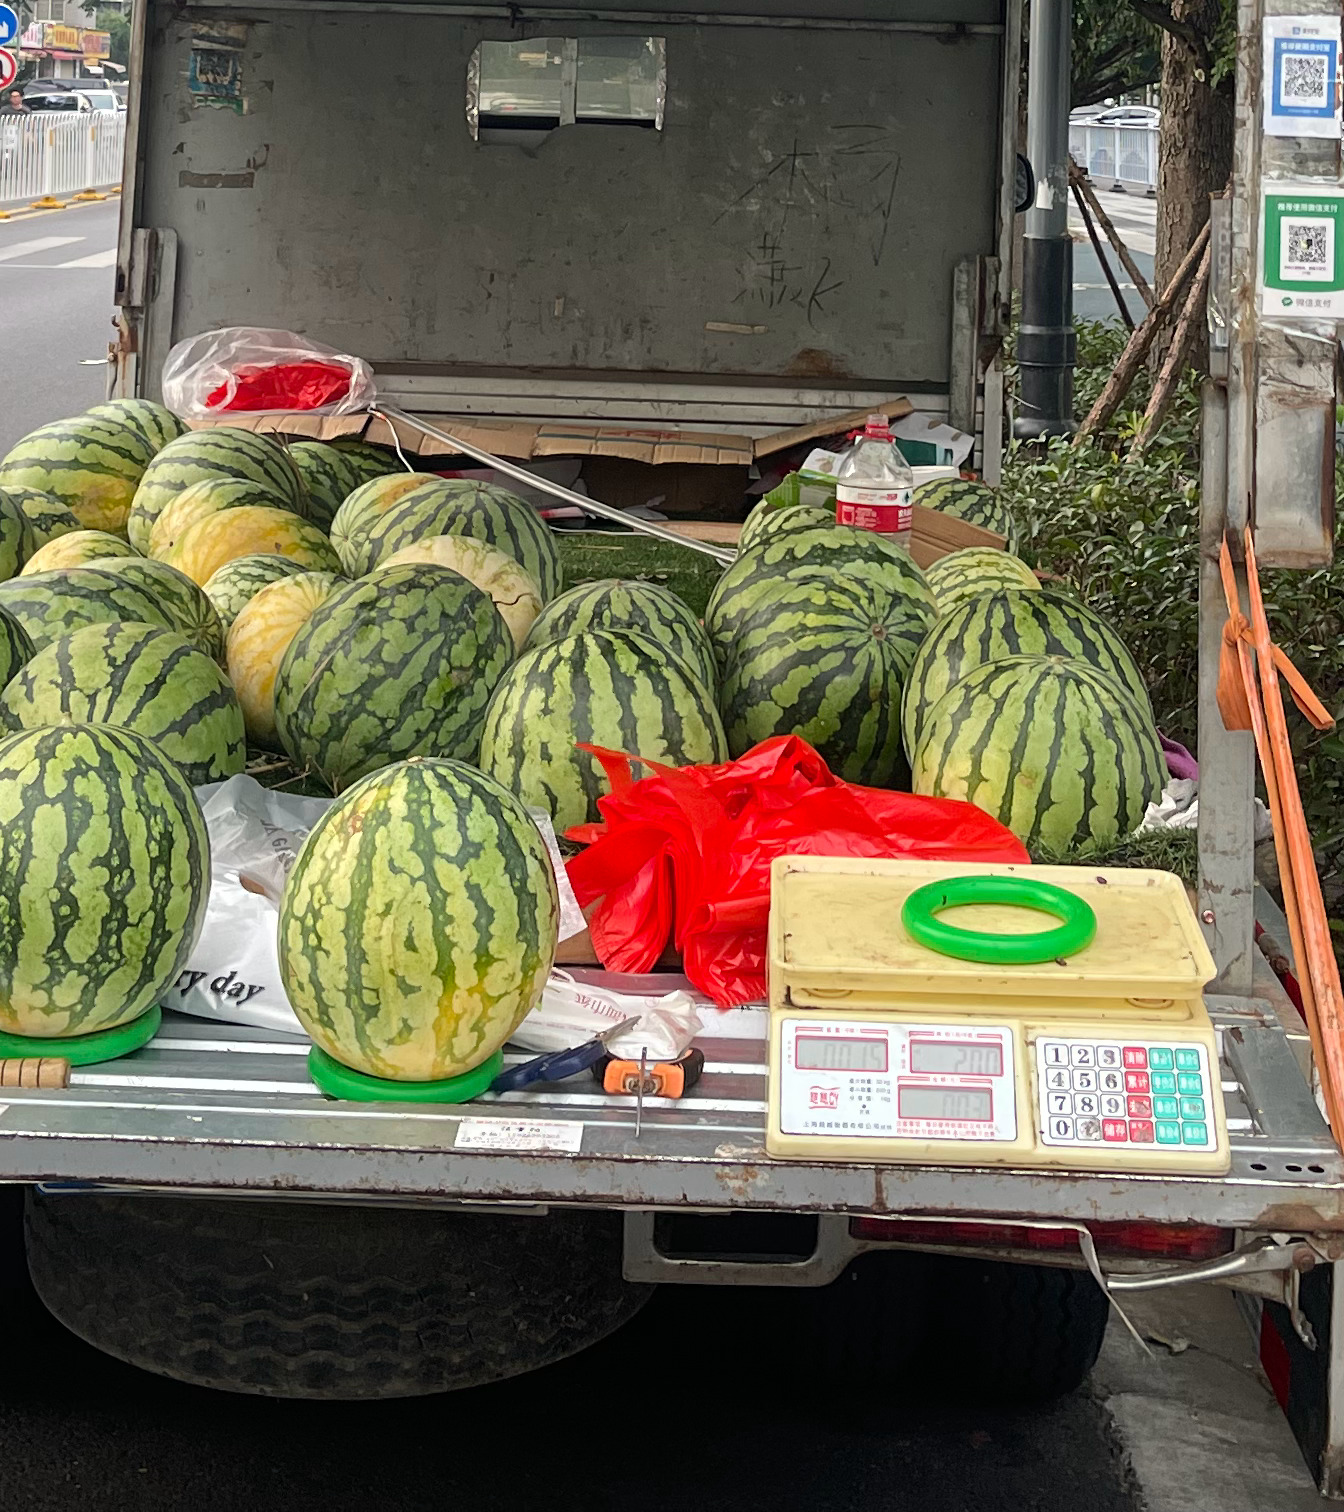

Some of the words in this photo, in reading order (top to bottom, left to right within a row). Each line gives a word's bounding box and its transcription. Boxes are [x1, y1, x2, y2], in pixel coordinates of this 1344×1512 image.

[1295, 298, 1332, 309] 微信支付
[210, 970, 265, 1008] day
[1051, 1047, 1062, 1064] 1
[1077, 1048, 1090, 1064] 2
[1103, 1049, 1116, 1065] 3
[1051, 1071, 1065, 1088] 4
[1079, 1072, 1091, 1088] 5
[1105, 1073, 1118, 1089] 6
[1054, 1095, 1067, 1111] 7
[1080, 1096, 1094, 1113] 8
[1106, 1097, 1120, 1114] 9
[1055, 1119, 1069, 1136] 0
